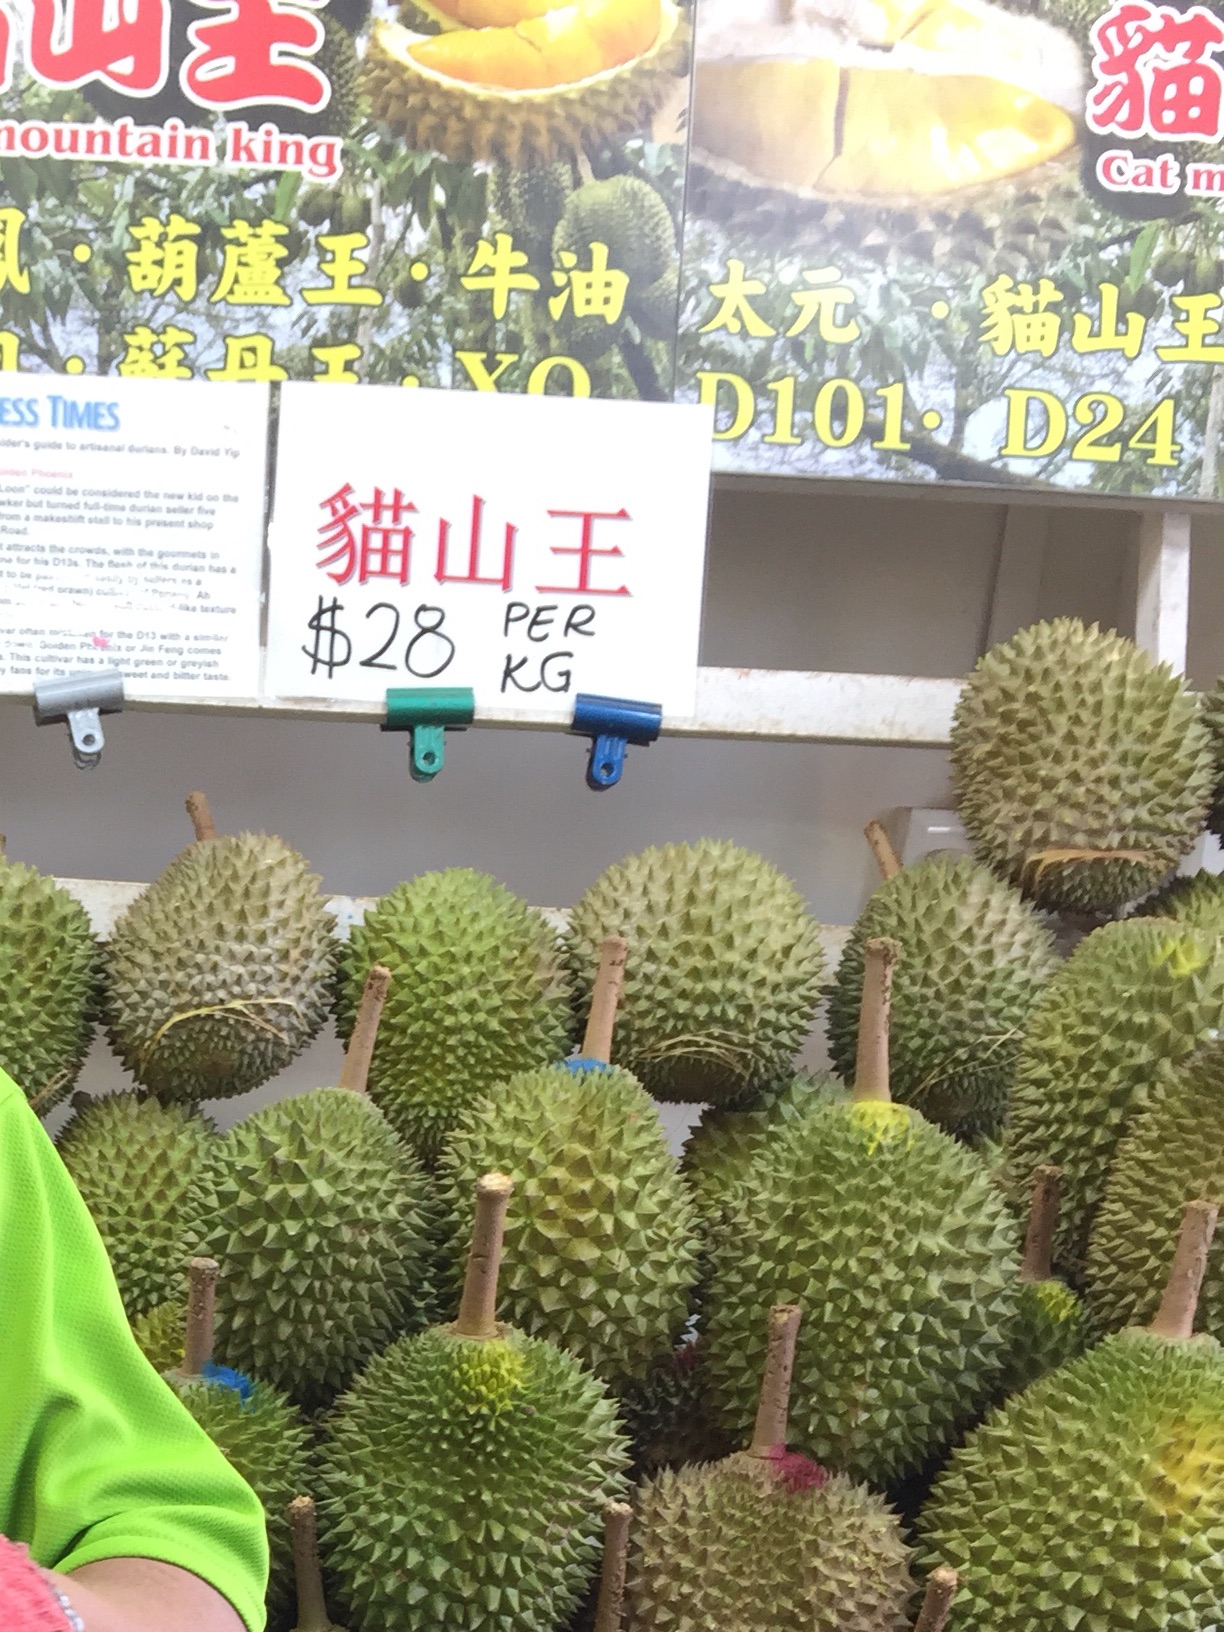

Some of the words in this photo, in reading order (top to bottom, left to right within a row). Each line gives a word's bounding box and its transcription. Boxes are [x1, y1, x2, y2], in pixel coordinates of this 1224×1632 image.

[230, 127, 341, 175] king
[1102, 155, 1174, 188] Cat
[48, 395, 121, 432] TIMES
[1001, 388, 1182, 467] D24
[144, 490, 159, 499] the
[223, 494, 238, 502] the
[49, 544, 64, 553] the
[138, 548, 153, 557] the
[315, 482, 632, 597] 貓山王
[302, 595, 455, 679] $28
[503, 601, 596, 642] PER
[500, 652, 575, 693] KG
